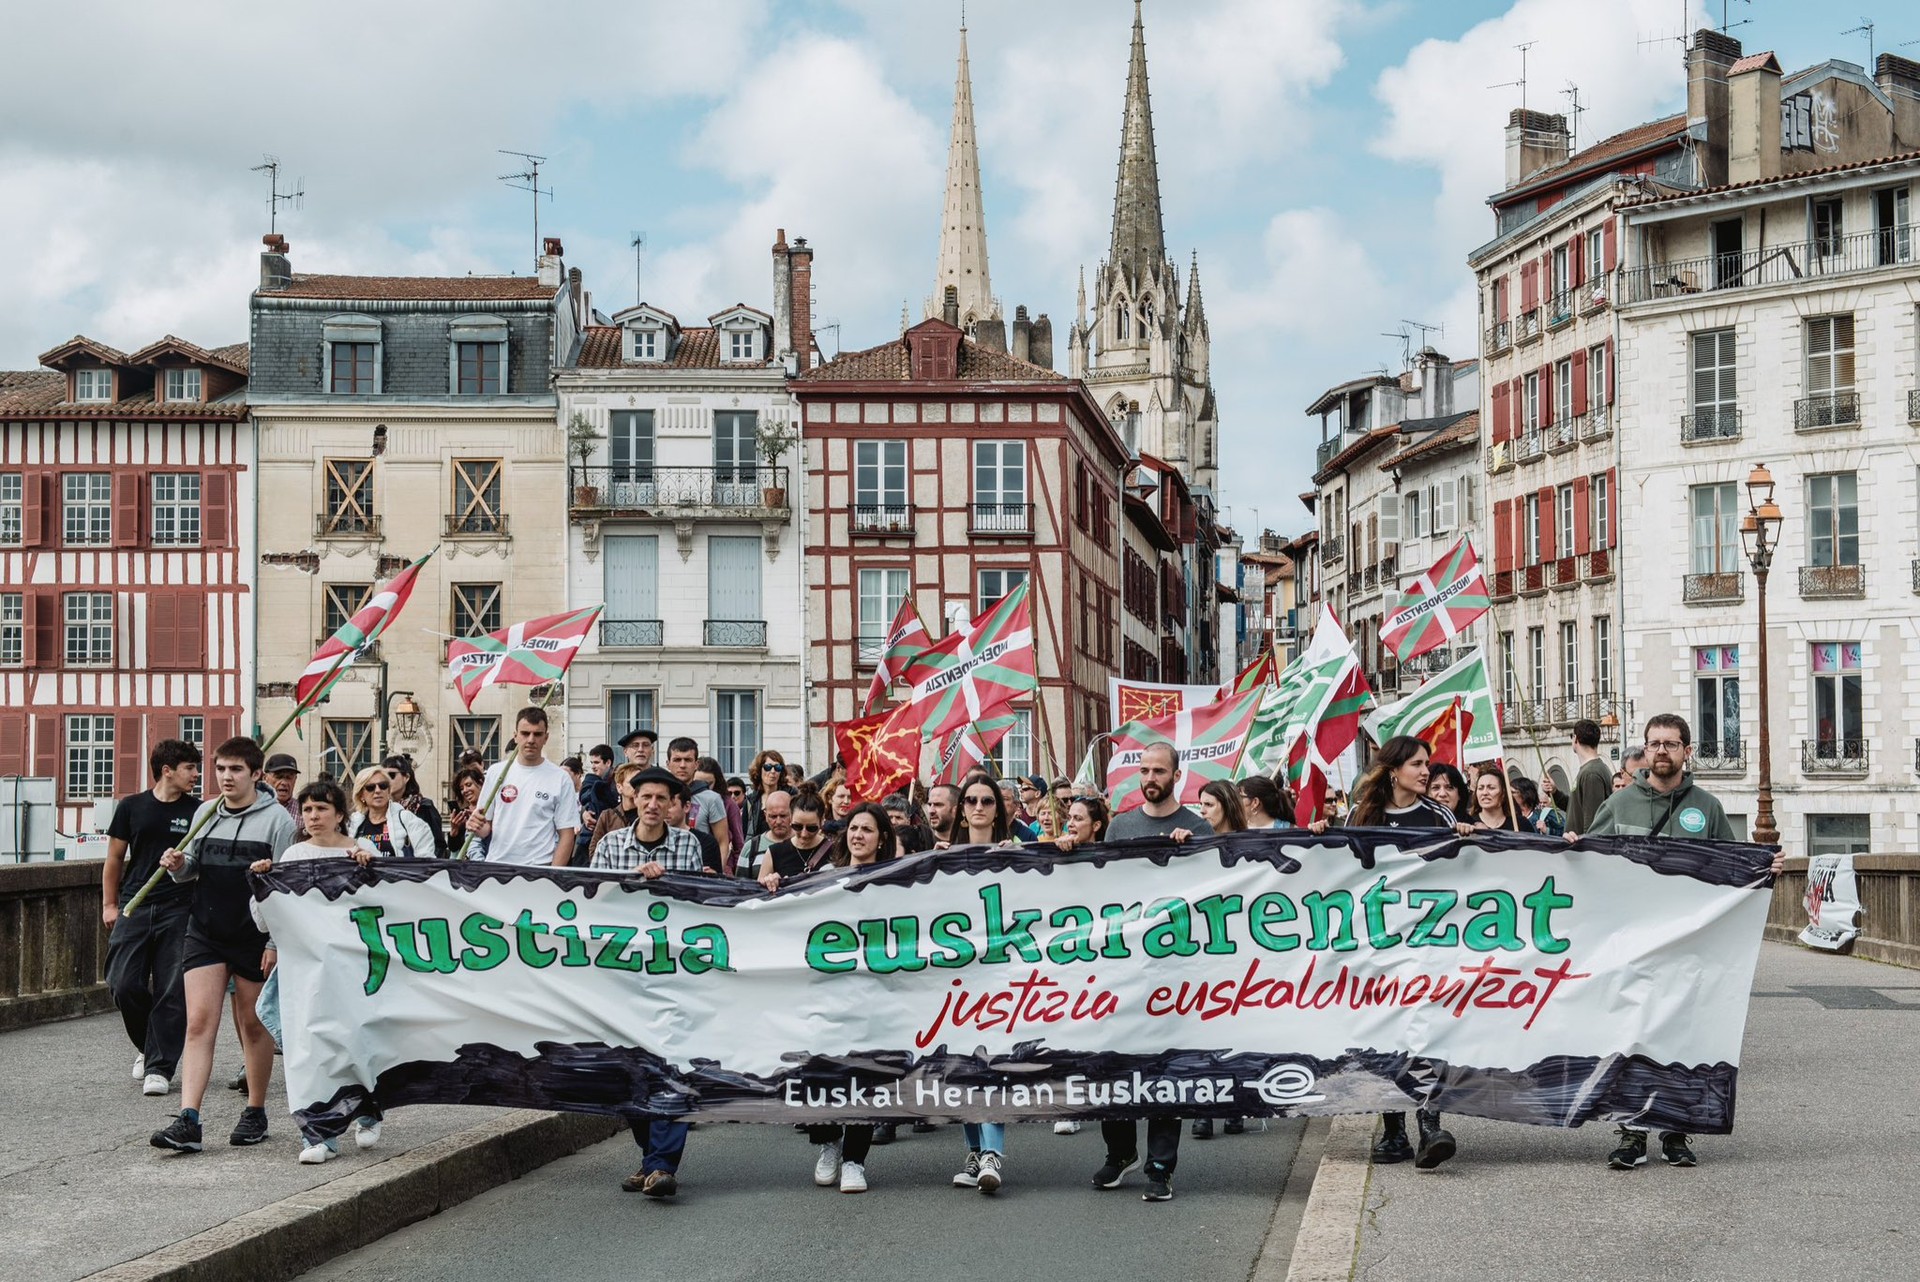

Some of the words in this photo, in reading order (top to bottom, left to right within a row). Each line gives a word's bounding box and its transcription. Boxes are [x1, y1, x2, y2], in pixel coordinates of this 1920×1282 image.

[349, 900, 737, 996] Justizia
[806, 876, 1574, 974] euskararentzat
[914, 969, 1120, 1049] justizia
[785, 1078, 904, 1109] Euskal
[914, 1078, 1057, 1108] Herrian
[1064, 1072, 1235, 1107] Euskaraz
